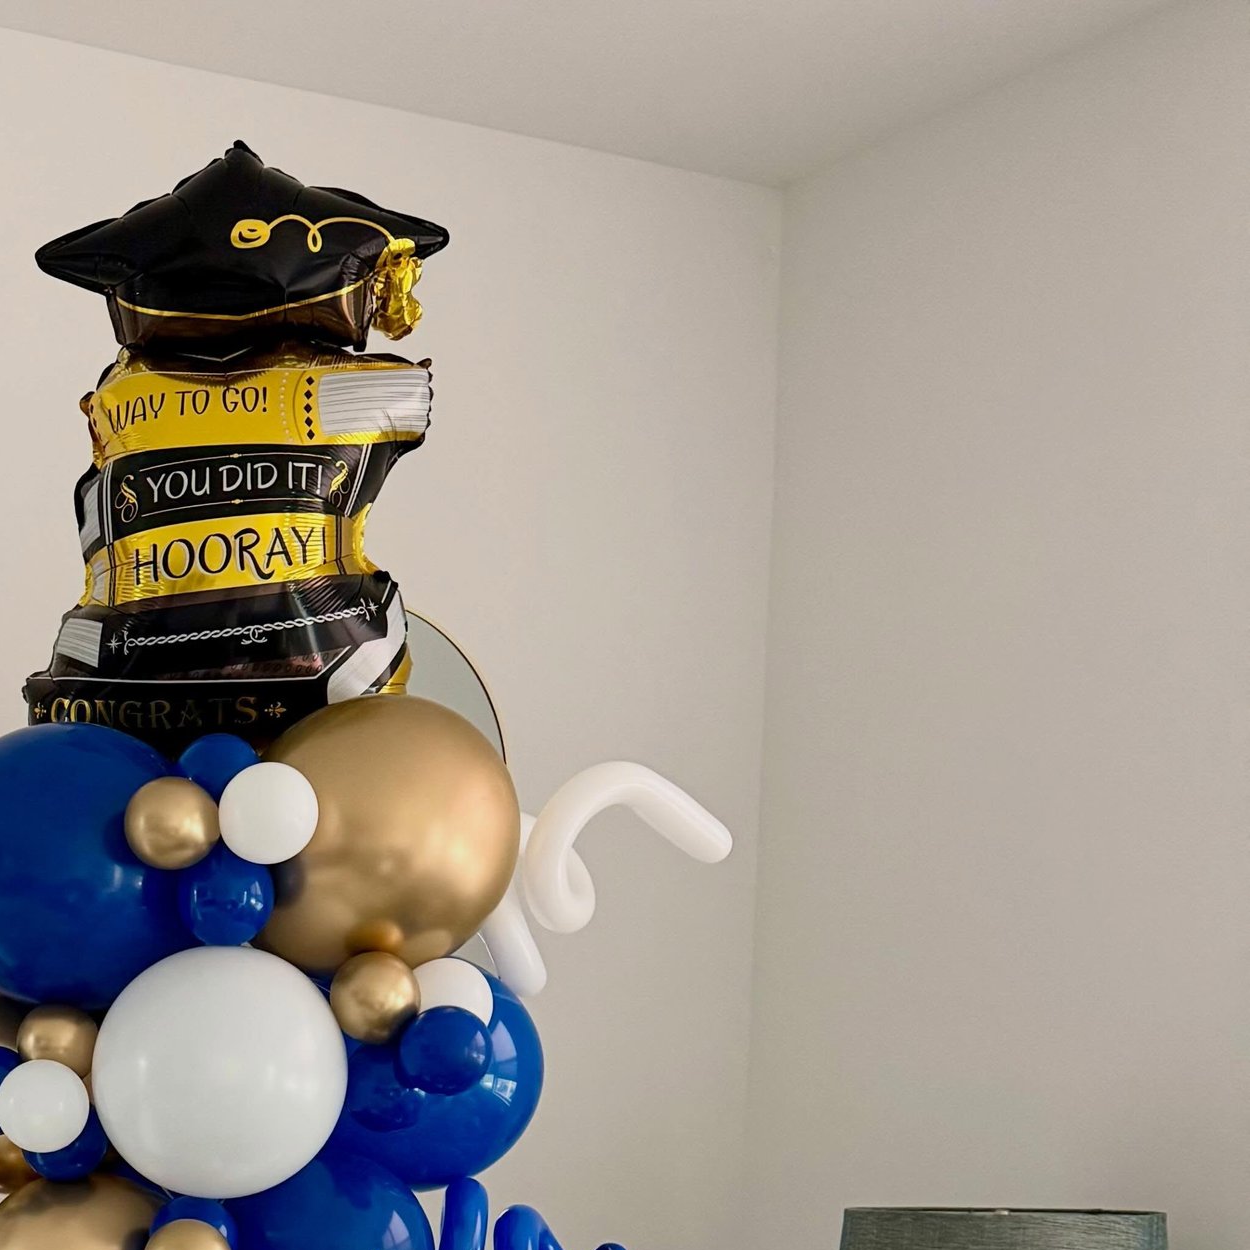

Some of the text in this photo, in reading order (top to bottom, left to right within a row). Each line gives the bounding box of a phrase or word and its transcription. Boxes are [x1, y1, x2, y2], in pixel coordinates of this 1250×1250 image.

[107, 386, 268, 434] WAY TO GO!
[146, 461, 323, 504] YOU DID IT!
[132, 526, 327, 587] HOORAY!
[50, 696, 259, 729] CONGRATS
